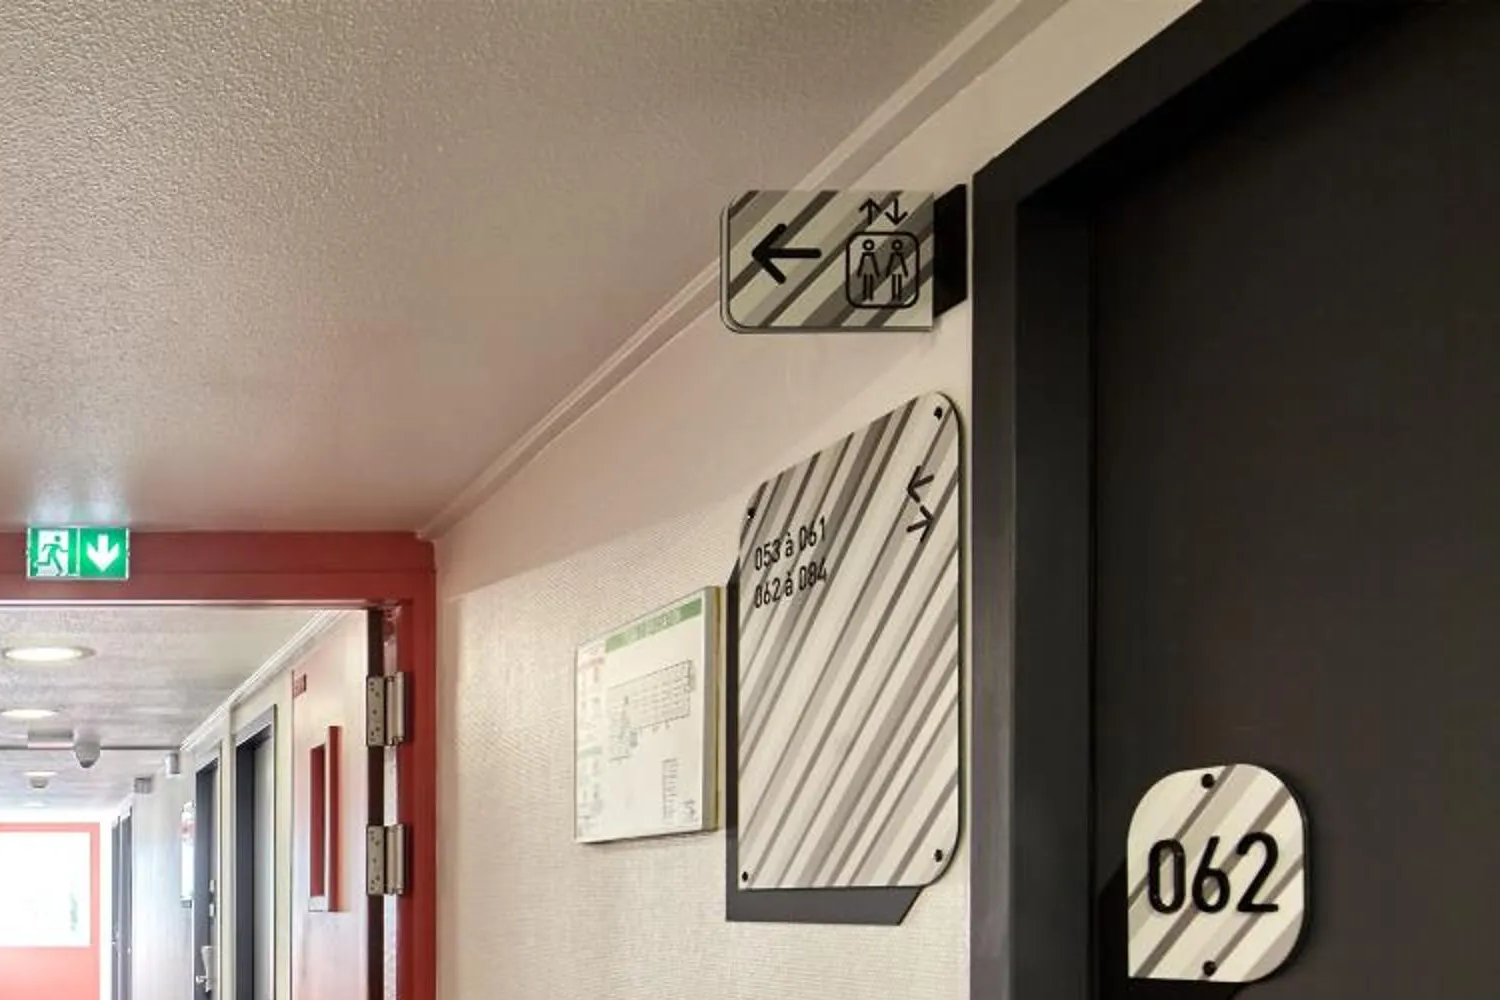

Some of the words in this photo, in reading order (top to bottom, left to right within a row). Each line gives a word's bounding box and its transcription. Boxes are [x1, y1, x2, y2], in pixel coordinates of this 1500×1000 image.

[754, 538, 781, 571] 053
[799, 516, 825, 551] 061
[754, 577, 781, 608] 062
[799, 557, 827, 591] 084
[1147, 831, 1280, 914] 062
